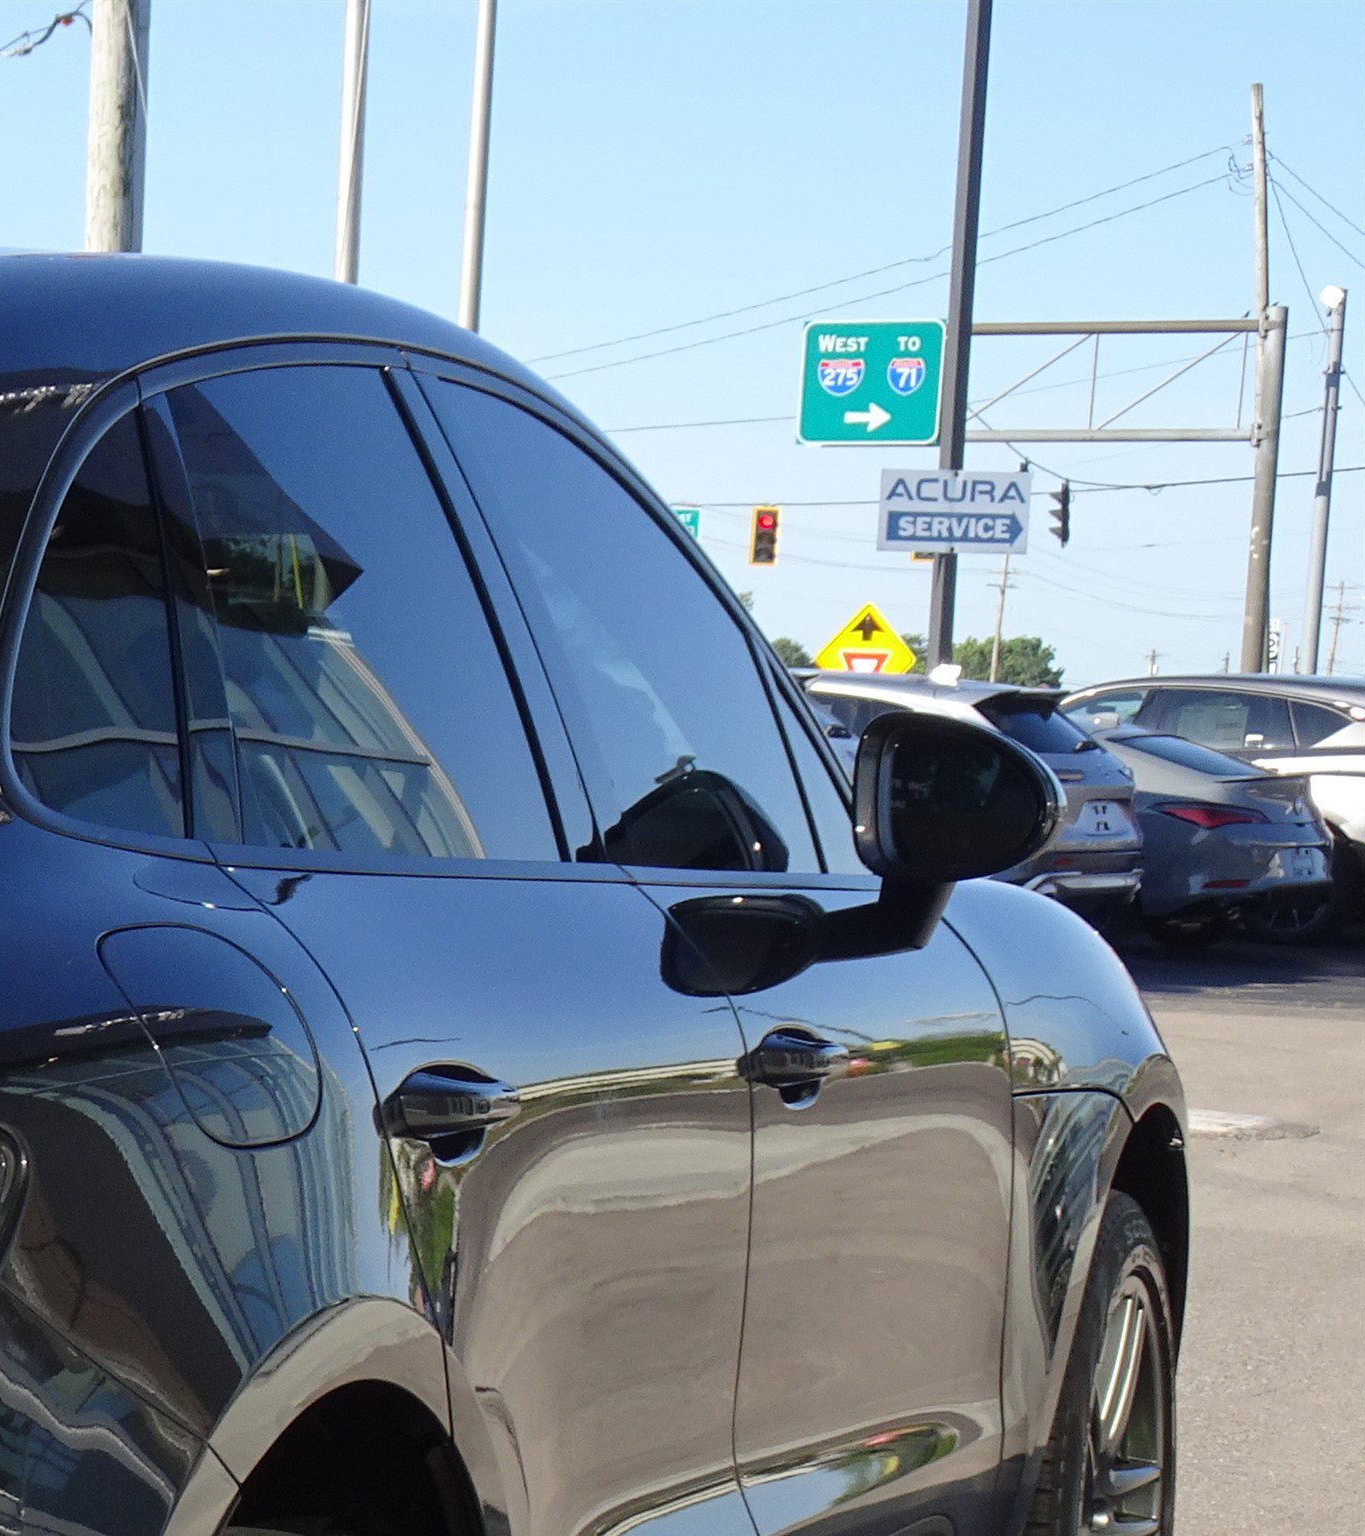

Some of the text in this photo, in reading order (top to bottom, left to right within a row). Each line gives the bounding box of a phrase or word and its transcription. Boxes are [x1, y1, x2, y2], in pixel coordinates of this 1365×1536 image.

[818, 334, 922, 352] WEST TO
[822, 368, 859, 386] 275
[896, 367, 917, 388] 71
[886, 478, 1026, 503] ACURA
[897, 516, 1012, 540] SERVICE
